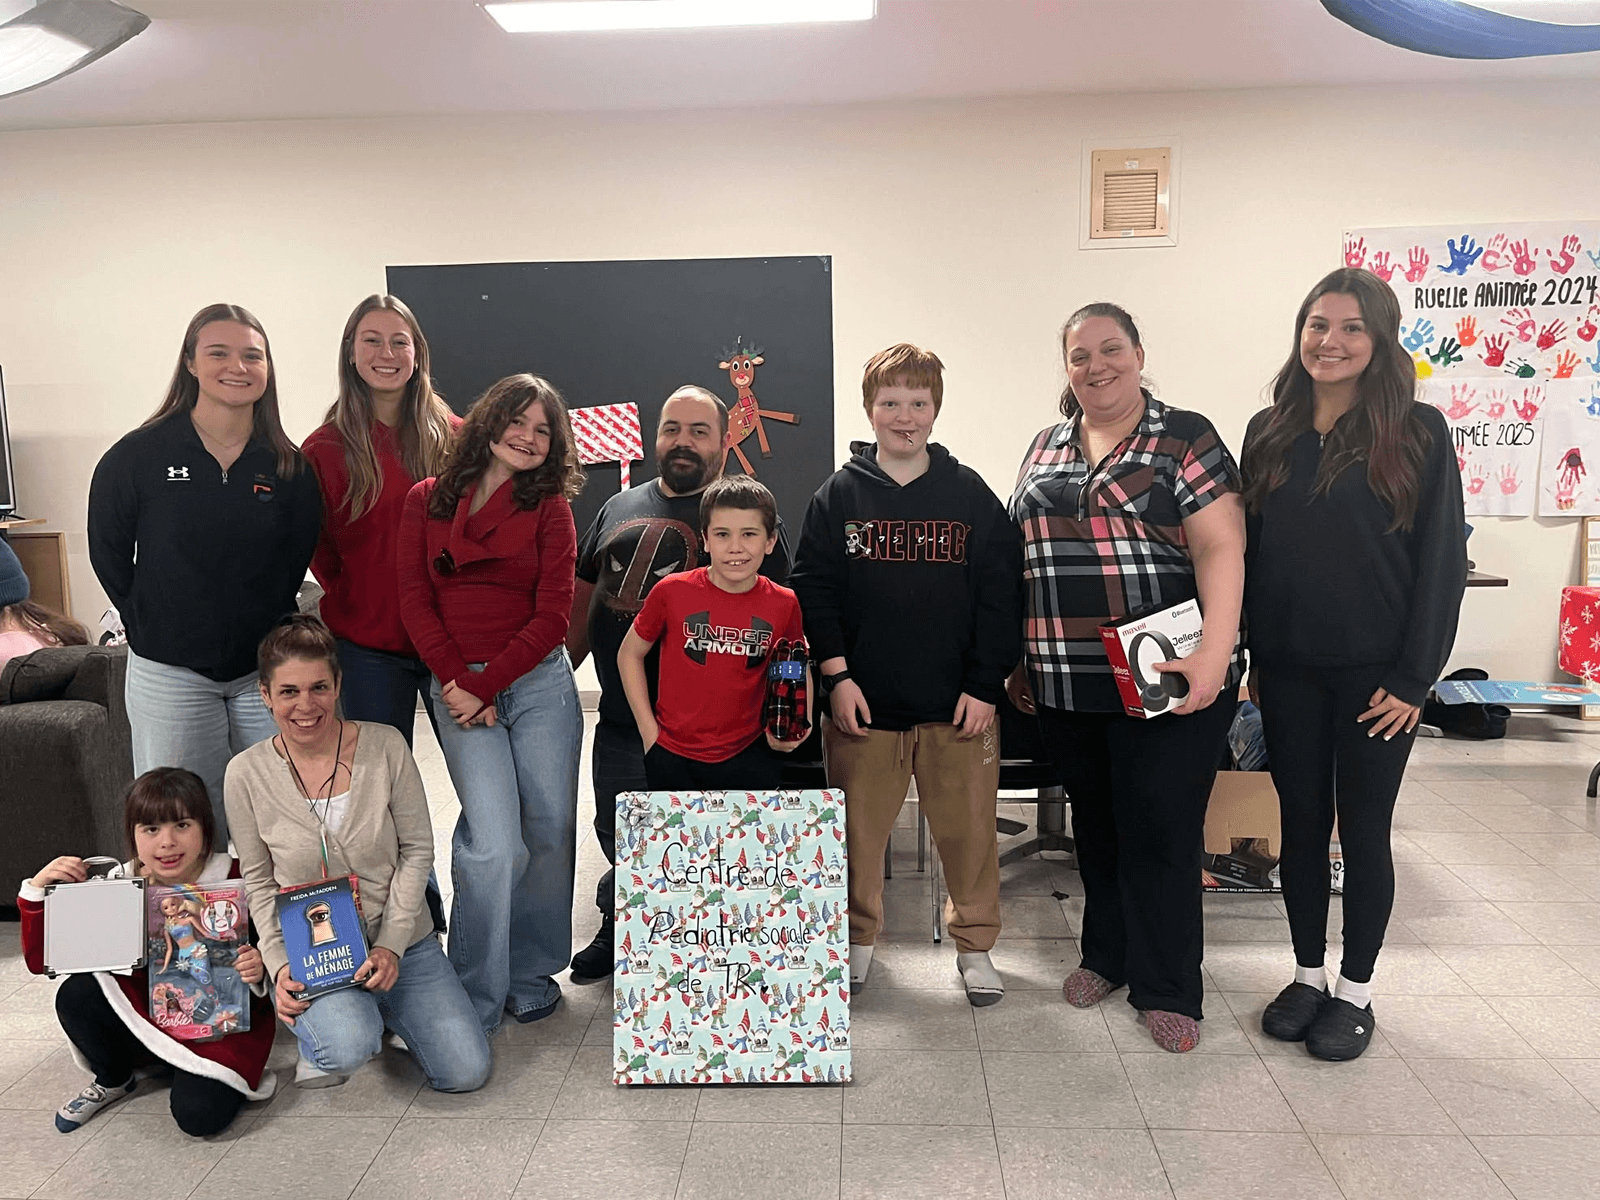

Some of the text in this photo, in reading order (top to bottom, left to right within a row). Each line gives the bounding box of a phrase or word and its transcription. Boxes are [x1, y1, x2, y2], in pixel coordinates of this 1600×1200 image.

[1541, 275, 1598, 306] 2024
[1496, 422, 1535, 446] 2025
[683, 622, 773, 646] UNDER
[1122, 622, 1147, 637] maxell
[684, 638, 770, 657] ARMOUR
[662, 842, 796, 888] Centre de
[290, 885, 337, 901] FREIDA McFADDEN
[648, 911, 811, 947] Pédiatrie sociale
[303, 944, 352, 968] LA FEMME
[306, 971, 315, 981] DE
[315, 957, 355, 978] MÉNAGE
[677, 965, 704, 994] de
[156, 1011, 194, 1028] Barbie
